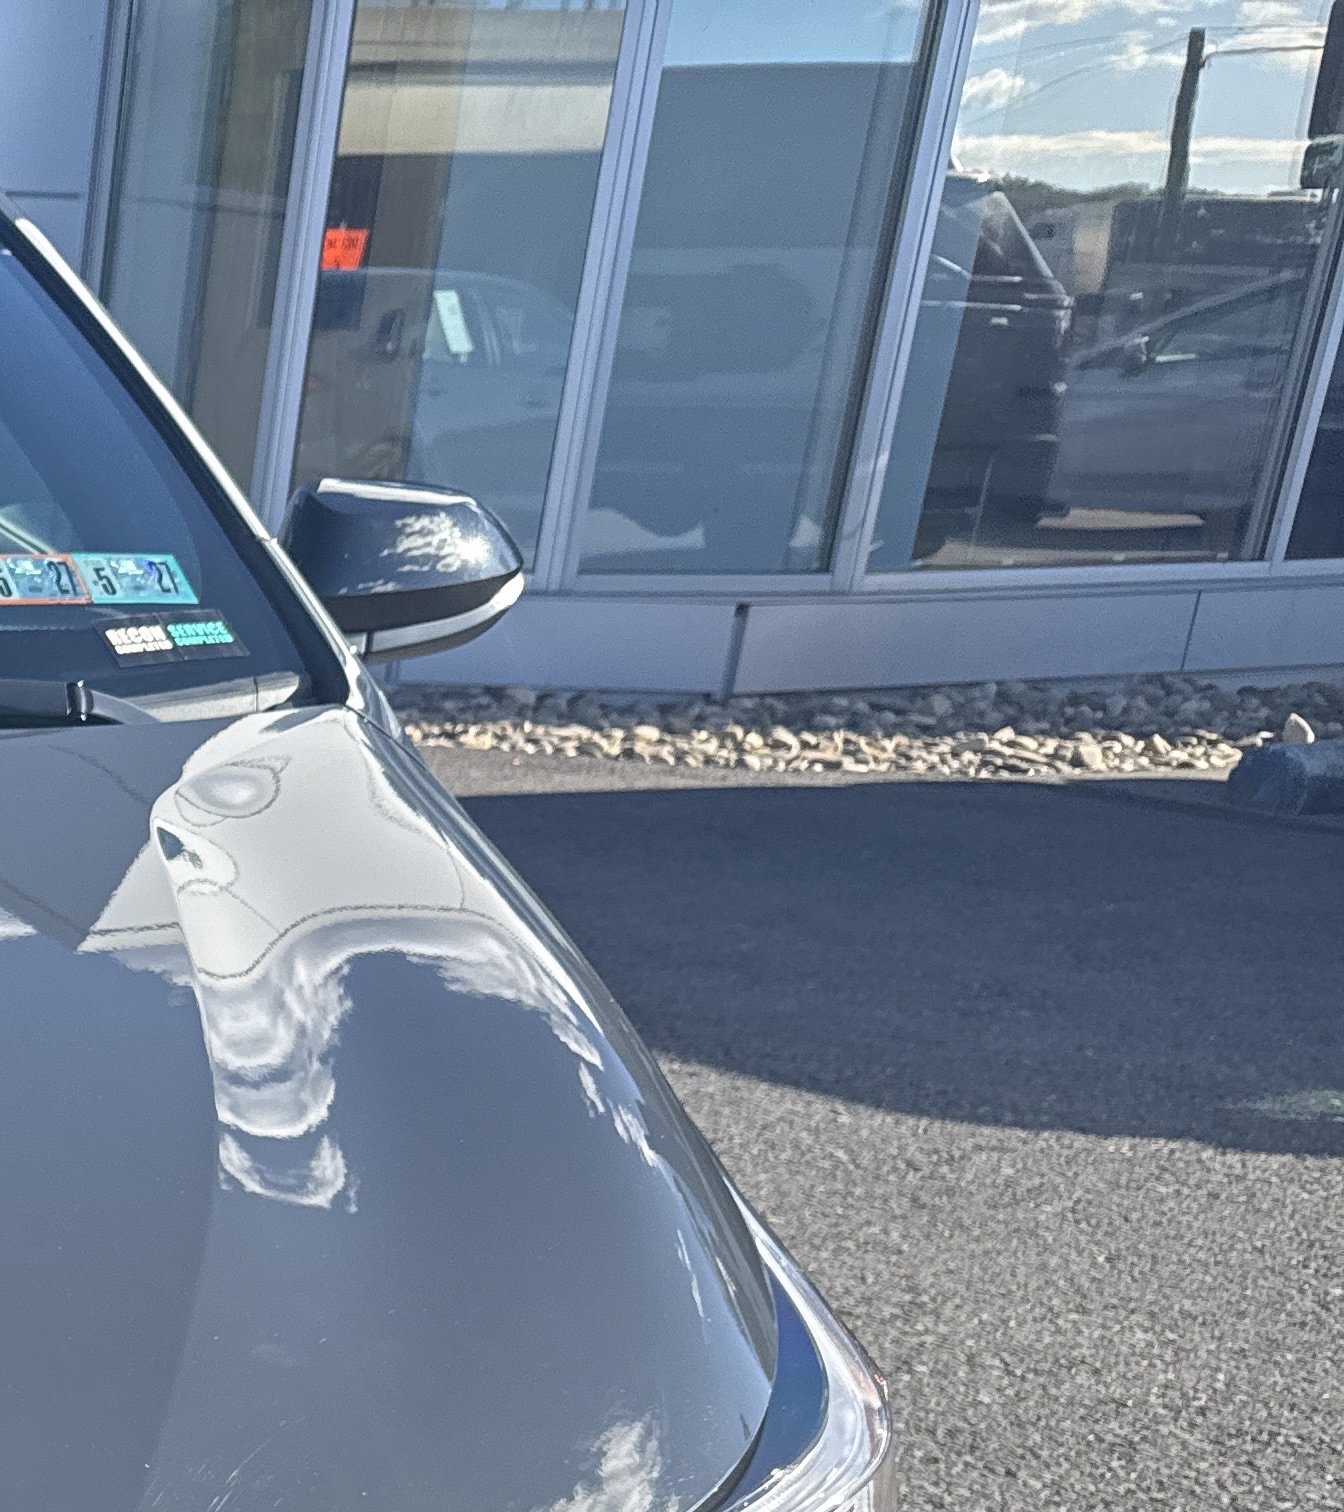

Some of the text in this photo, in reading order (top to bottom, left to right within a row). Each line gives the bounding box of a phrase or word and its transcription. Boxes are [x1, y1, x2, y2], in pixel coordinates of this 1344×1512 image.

[47, 560, 77, 596] 27
[148, 560, 179, 595] 27
[105, 625, 167, 645] RECON
[167, 620, 228, 637] SERVICE
